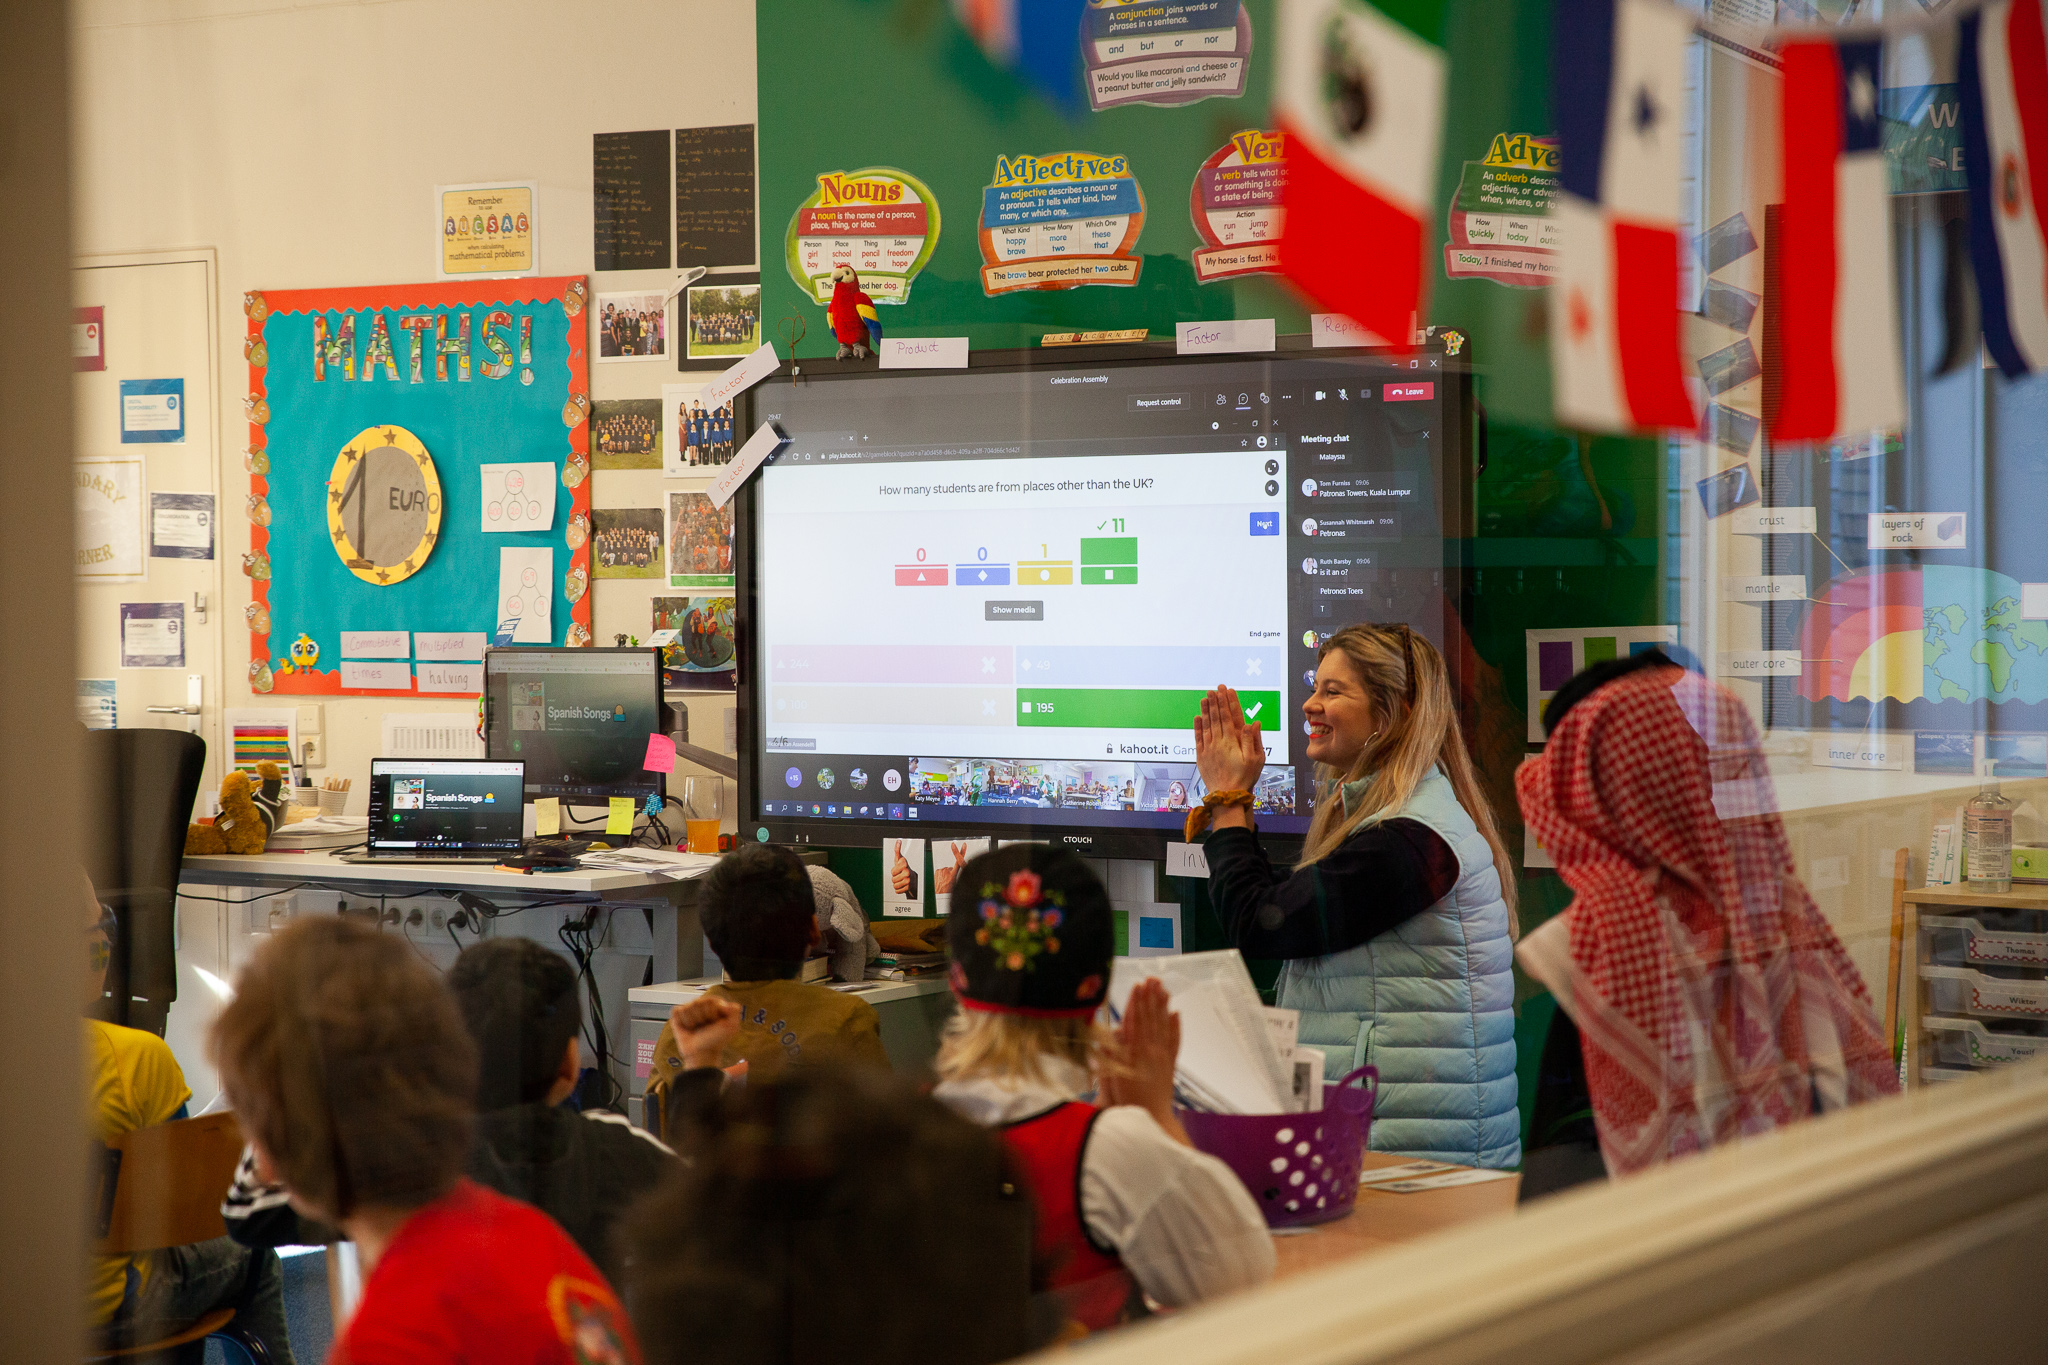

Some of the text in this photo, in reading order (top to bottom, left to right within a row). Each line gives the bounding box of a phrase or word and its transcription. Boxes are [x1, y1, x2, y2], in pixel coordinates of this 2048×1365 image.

[1109, 2, 1218, 22] A conjunction joins words or
[1109, 21, 1138, 33] phrases
[1138, 20, 1146, 28] in
[1153, 16, 1188, 27] sentence.
[1174, 39, 1183, 47] or
[1204, 35, 1218, 44] nor
[1108, 44, 1124, 54] and
[1140, 41, 1154, 50] but
[1234, 132, 1284, 163] Ver
[1486, 134, 1560, 167] Adve
[994, 155, 1125, 186] Adjectives
[820, 174, 901, 206] Nouns
[468, 195, 503, 206] Remember
[1249, 220, 1268, 230] jump
[1225, 232, 1234, 240] sit
[1252, 230, 1266, 238] talk
[1468, 229, 1494, 240] quickly
[1506, 232, 1528, 242] today
[480, 243, 504, 251] calculating
[448, 249, 526, 260] mathematical problems
[807, 250, 818, 259] girl
[832, 249, 852, 258] school
[861, 249, 880, 258] pencil
[887, 249, 914, 257] freedom
[807, 260, 818, 268] boy
[864, 260, 876, 268] dog
[892, 259, 908, 268] hope
[993, 271, 1006, 280] The
[1007, 270, 1027, 280] brave
[1028, 269, 1044, 278] bear
[1046, 267, 1080, 278] protected
[1081, 265, 1092, 274] her
[1110, 263, 1129, 272] cubs.
[573, 282, 584, 296] 50
[1044, 334, 1072, 342] MISS
[1186, 326, 1222, 348] Factor
[313, 310, 534, 386] MATHS!
[896, 340, 940, 355] Product
[1050, 374, 1108, 385] Celebration Assembly
[710, 369, 748, 402] Factor
[1405, 387, 1424, 396] Leave
[574, 394, 586, 408] 32
[1136, 397, 1181, 407] Request control
[767, 413, 782, 421] 29:47
[1301, 434, 1350, 444] Meeting chat
[573, 455, 584, 468] 72
[1319, 453, 1346, 462] Malaysia
[718, 458, 746, 494] Factor
[879, 478, 1154, 497] How many students are from places other than the UK?
[1369, 488, 1386, 496] Kuala
[1387, 488, 1411, 498] Lumpur
[389, 486, 440, 514] EURO
[509, 506, 520, 516] 20
[574, 514, 585, 527] 56
[1112, 518, 1124, 532] 11
[1345, 518, 1374, 526] Whitmarsh
[1759, 515, 1785, 526] crust
[1882, 517, 1925, 530] layers of
[1319, 530, 1346, 538] Petronas
[1892, 533, 1914, 543] rock
[916, 547, 926, 562] 0
[977, 546, 988, 562] 0
[1041, 543, 1048, 558] 1
[1333, 558, 1352, 566] Barsby
[523, 571, 535, 582] 69
[573, 568, 584, 580] 80
[1320, 568, 1325, 576] is
[1326, 568, 1331, 576] it
[1340, 568, 1348, 576] o?
[1347, 587, 1364, 595] Toers
[1745, 583, 1780, 594] mantle
[508, 600, 520, 610] 60
[539, 600, 545, 611] 9
[992, 605, 1036, 614] Show media
[575, 626, 586, 638] 36
[789, 659, 810, 669] 244
[1036, 659, 1050, 670] 49
[1732, 660, 1786, 669] outer core
[352, 668, 382, 680] times
[428, 669, 468, 690] halving
[547, 705, 612, 722] Spanish Songs
[1036, 702, 1054, 714] 195
[1120, 743, 1196, 756] kahoot.it Gam
[1828, 749, 1886, 762] inner core
[425, 793, 483, 804] Spanish Songs
[1063, 836, 1092, 844] CTOUCH
[894, 905, 912, 914] agree
[2005, 946, 2036, 956] Thomas
[2009, 996, 2037, 1006] Wiktor
[2011, 1047, 2034, 1056] Yousif
